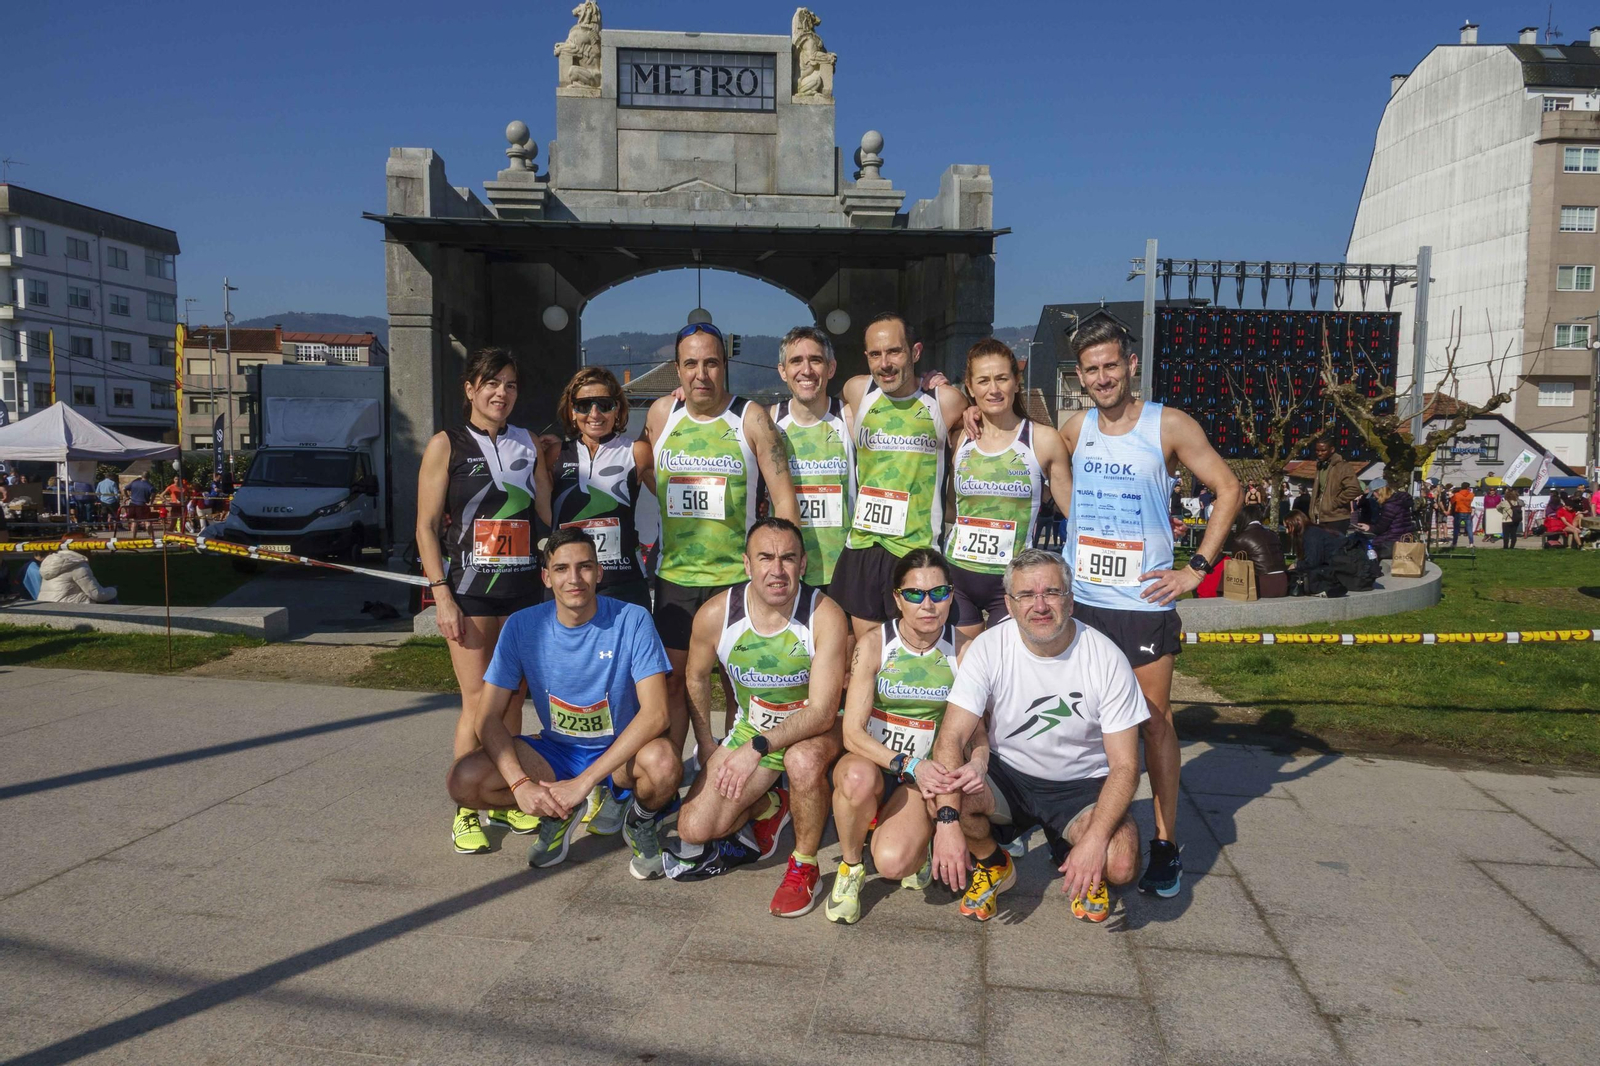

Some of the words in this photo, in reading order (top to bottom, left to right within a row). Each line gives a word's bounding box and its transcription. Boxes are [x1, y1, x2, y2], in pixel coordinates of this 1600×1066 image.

[632, 64, 759, 97] METRO
[859, 428, 937, 450] Natursueño
[660, 450, 742, 471] Natursueño
[788, 455, 848, 470] tursueño
[683, 490, 708, 510] 518
[800, 500, 826, 518] 261
[864, 502, 892, 525] 260
[496, 536, 512, 555] 21
[968, 533, 999, 556] 253
[1090, 554, 1126, 578] 990
[729, 664, 809, 686] Natursueñ
[878, 678, 951, 698] Natursueñ
[558, 711, 603, 732] 2238
[760, 712, 788, 729] 25
